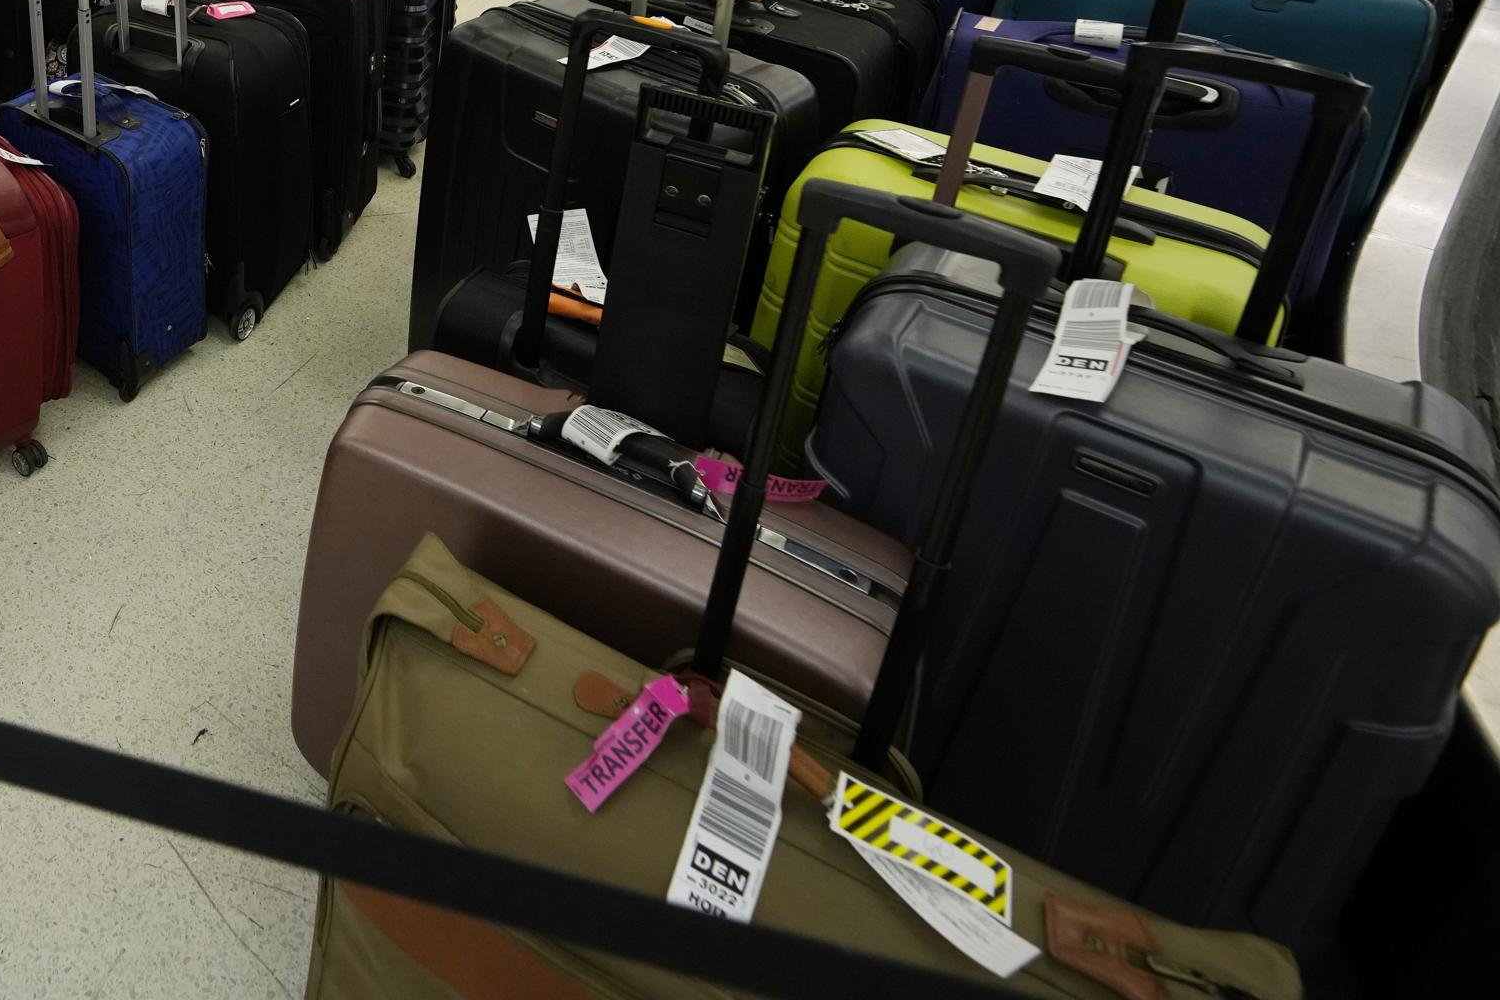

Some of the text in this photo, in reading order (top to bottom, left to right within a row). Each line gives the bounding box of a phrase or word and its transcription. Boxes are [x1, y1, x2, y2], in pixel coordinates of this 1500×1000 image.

[1056, 356, 1107, 371] DEN
[579, 701, 668, 795] TRANSFER
[693, 848, 748, 892] DEN
